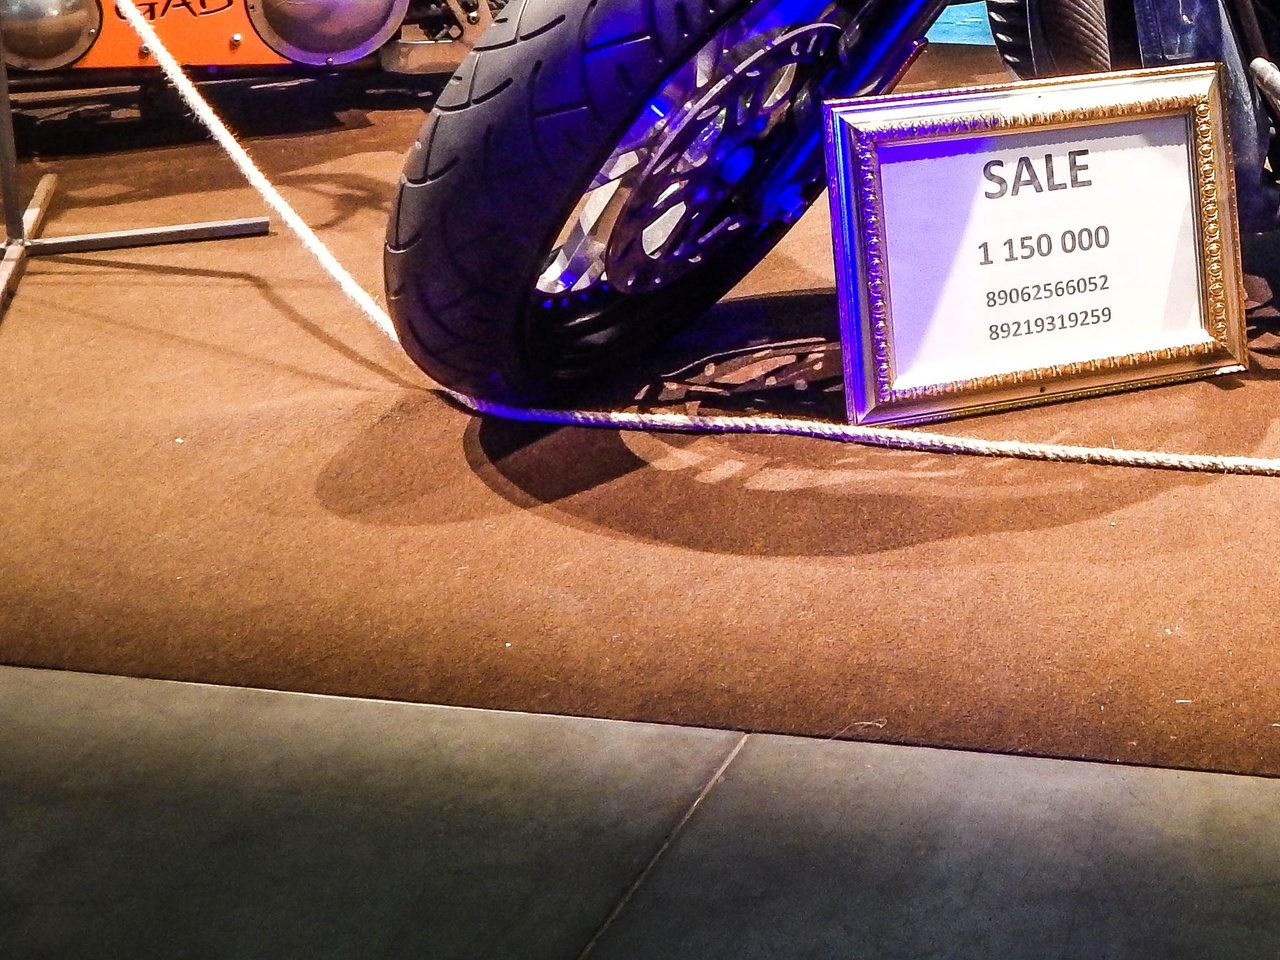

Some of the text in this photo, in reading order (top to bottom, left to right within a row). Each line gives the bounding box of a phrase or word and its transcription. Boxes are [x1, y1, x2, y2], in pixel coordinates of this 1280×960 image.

[982, 149, 1093, 200] SALE
[978, 225, 1110, 266] 1 150 000
[986, 274, 1110, 308] 89062566052
[988, 307, 1112, 341] 89219319259
